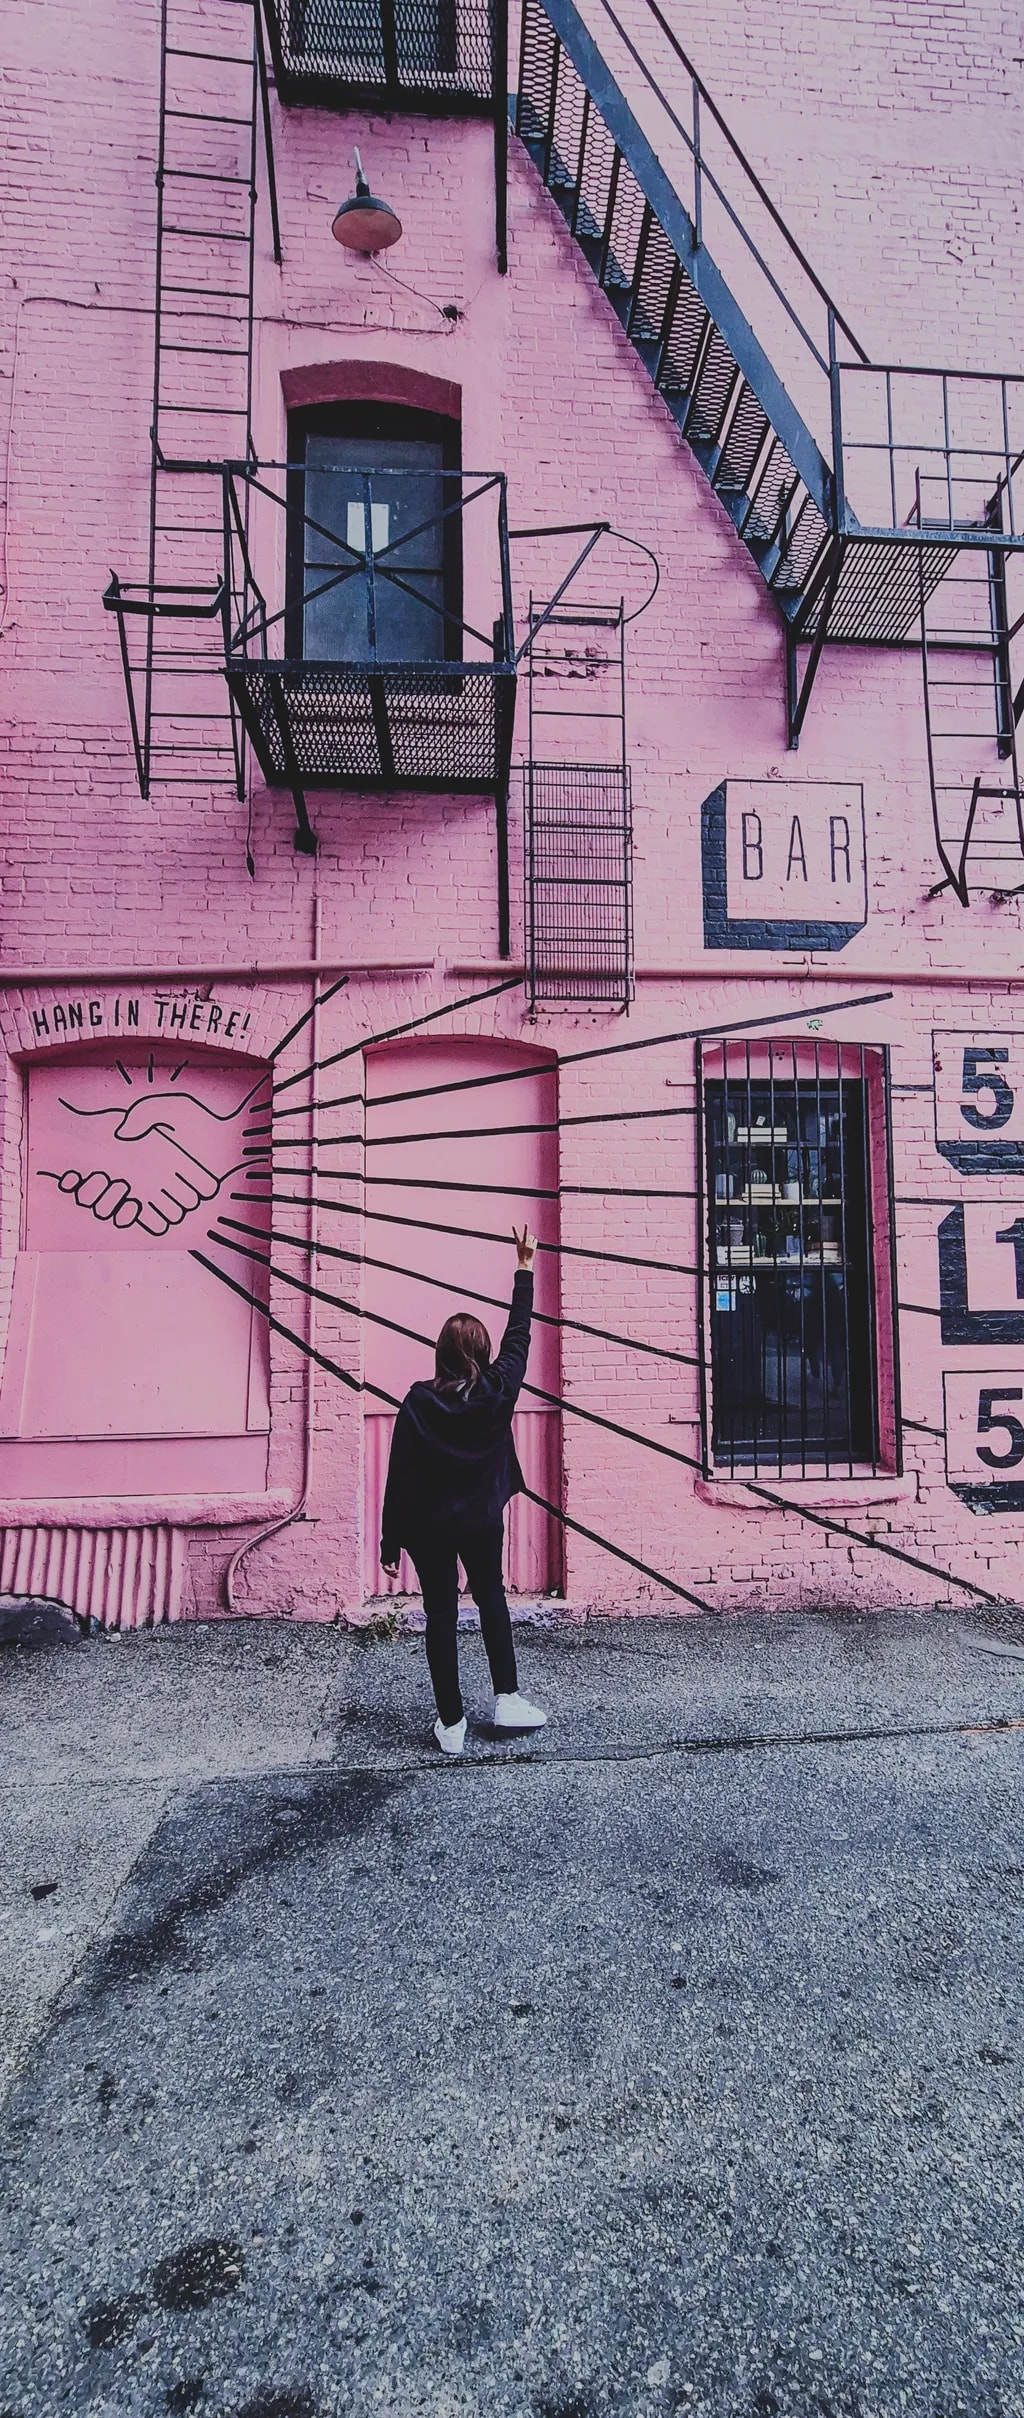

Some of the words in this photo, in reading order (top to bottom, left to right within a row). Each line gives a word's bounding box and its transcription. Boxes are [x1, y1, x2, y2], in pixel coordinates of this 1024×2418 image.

[741, 812, 851, 883] BAR
[32, 1001, 103, 1036] HANG
[114, 999, 140, 1026] IN
[154, 1001, 251, 1040] THERE!
[960, 1047, 1014, 1130] 5
[976, 1387, 1024, 1469] 5
